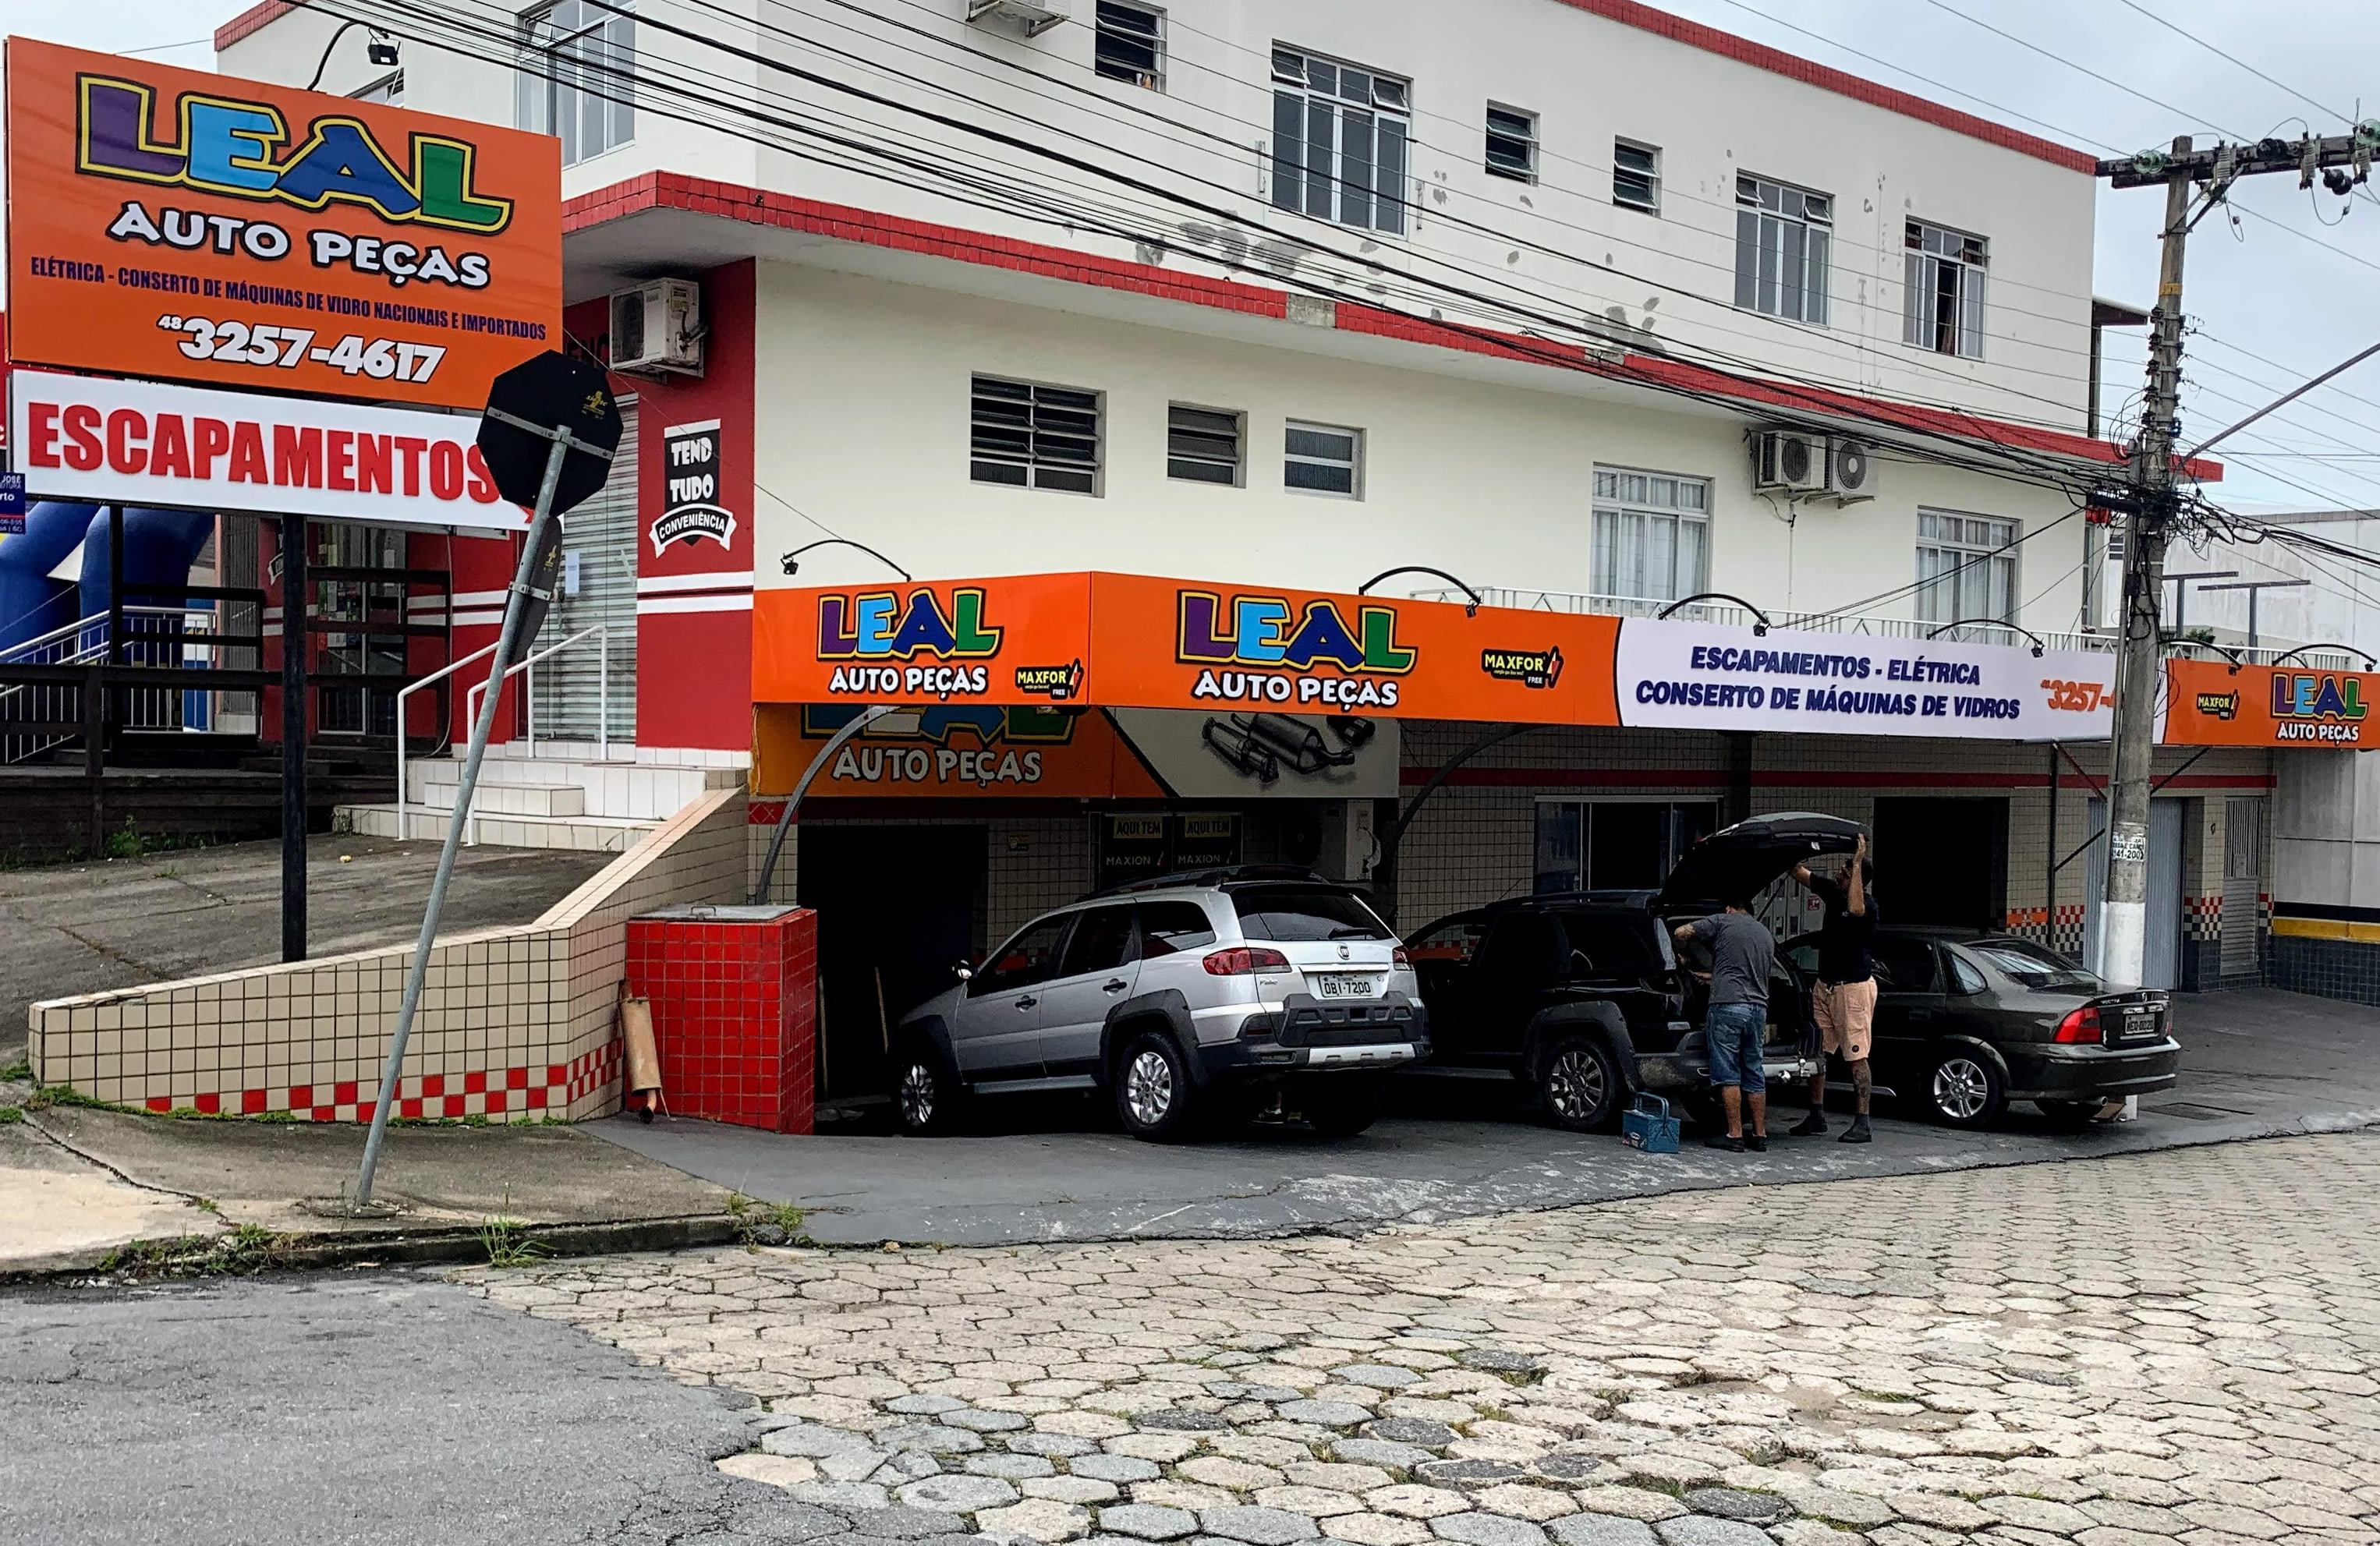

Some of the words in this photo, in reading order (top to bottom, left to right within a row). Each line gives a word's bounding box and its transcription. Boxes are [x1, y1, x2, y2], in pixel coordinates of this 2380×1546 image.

[76, 72, 514, 235] LEAL
[107, 203, 289, 260] AUTO
[309, 231, 491, 288] PEÇAS
[31, 256, 104, 283] ELÉTRICA
[119, 267, 199, 295] CONSERTO
[204, 278, 221, 298] DE
[225, 281, 303, 308] MÁQUINAS
[306, 292, 323, 311] DE
[328, 295, 370, 317] VIDRO
[374, 302, 448, 327] NACIONAIS
[452, 313, 458, 329] E
[462, 313, 546, 340] IMPORTADOS
[158, 314, 182, 331] 48
[177, 317, 447, 384] 3257-4617
[28, 401, 500, 504] ESCAPAMENTOS
[671, 437, 713, 467] TEND
[670, 473, 714, 503] TUDO
[658, 511, 725, 540] CONVENIÊNCIA
[817, 587, 1004, 661] LEAL
[1176, 589, 1418, 675] LEAL
[1018, 671, 1066, 684] MAXFOR
[1485, 654, 1543, 671] MAXFOR
[1691, 646, 1870, 680] ESCAPAMENTOS
[1887, 656, 1980, 685] ELÉTRICA
[829, 666, 899, 694] AUTO
[905, 667, 986, 700] PEÇAS
[1193, 670, 1291, 702] AUTO
[1299, 675, 1399, 711] PEÇAS
[1636, 680, 1765, 709] CONSERTO
[1770, 687, 1801, 710] DE
[1804, 685, 1916, 716] MÁQUINAS
[1921, 695, 1948, 716] DE
[1953, 696, 2021, 720] VIDROS
[2047, 679, 2115, 712] 3257-
[2271, 671, 2369, 721] LEAL
[2198, 696, 2229, 709] MAXFOR
[2277, 722, 2316, 741] AUTO
[2318, 723, 2360, 746] PEÇAS
[832, 745, 930, 780] AUTO
[936, 748, 1042, 787] PEÇAS
[1116, 822, 1140, 834] AQUI
[1142, 821, 1161, 834] TEM
[1187, 821, 1211, 833] AQUI
[1212, 820, 1230, 833] TEM
[1107, 856, 1150, 865] MAXION
[1178, 854, 1220, 864] MAXION
